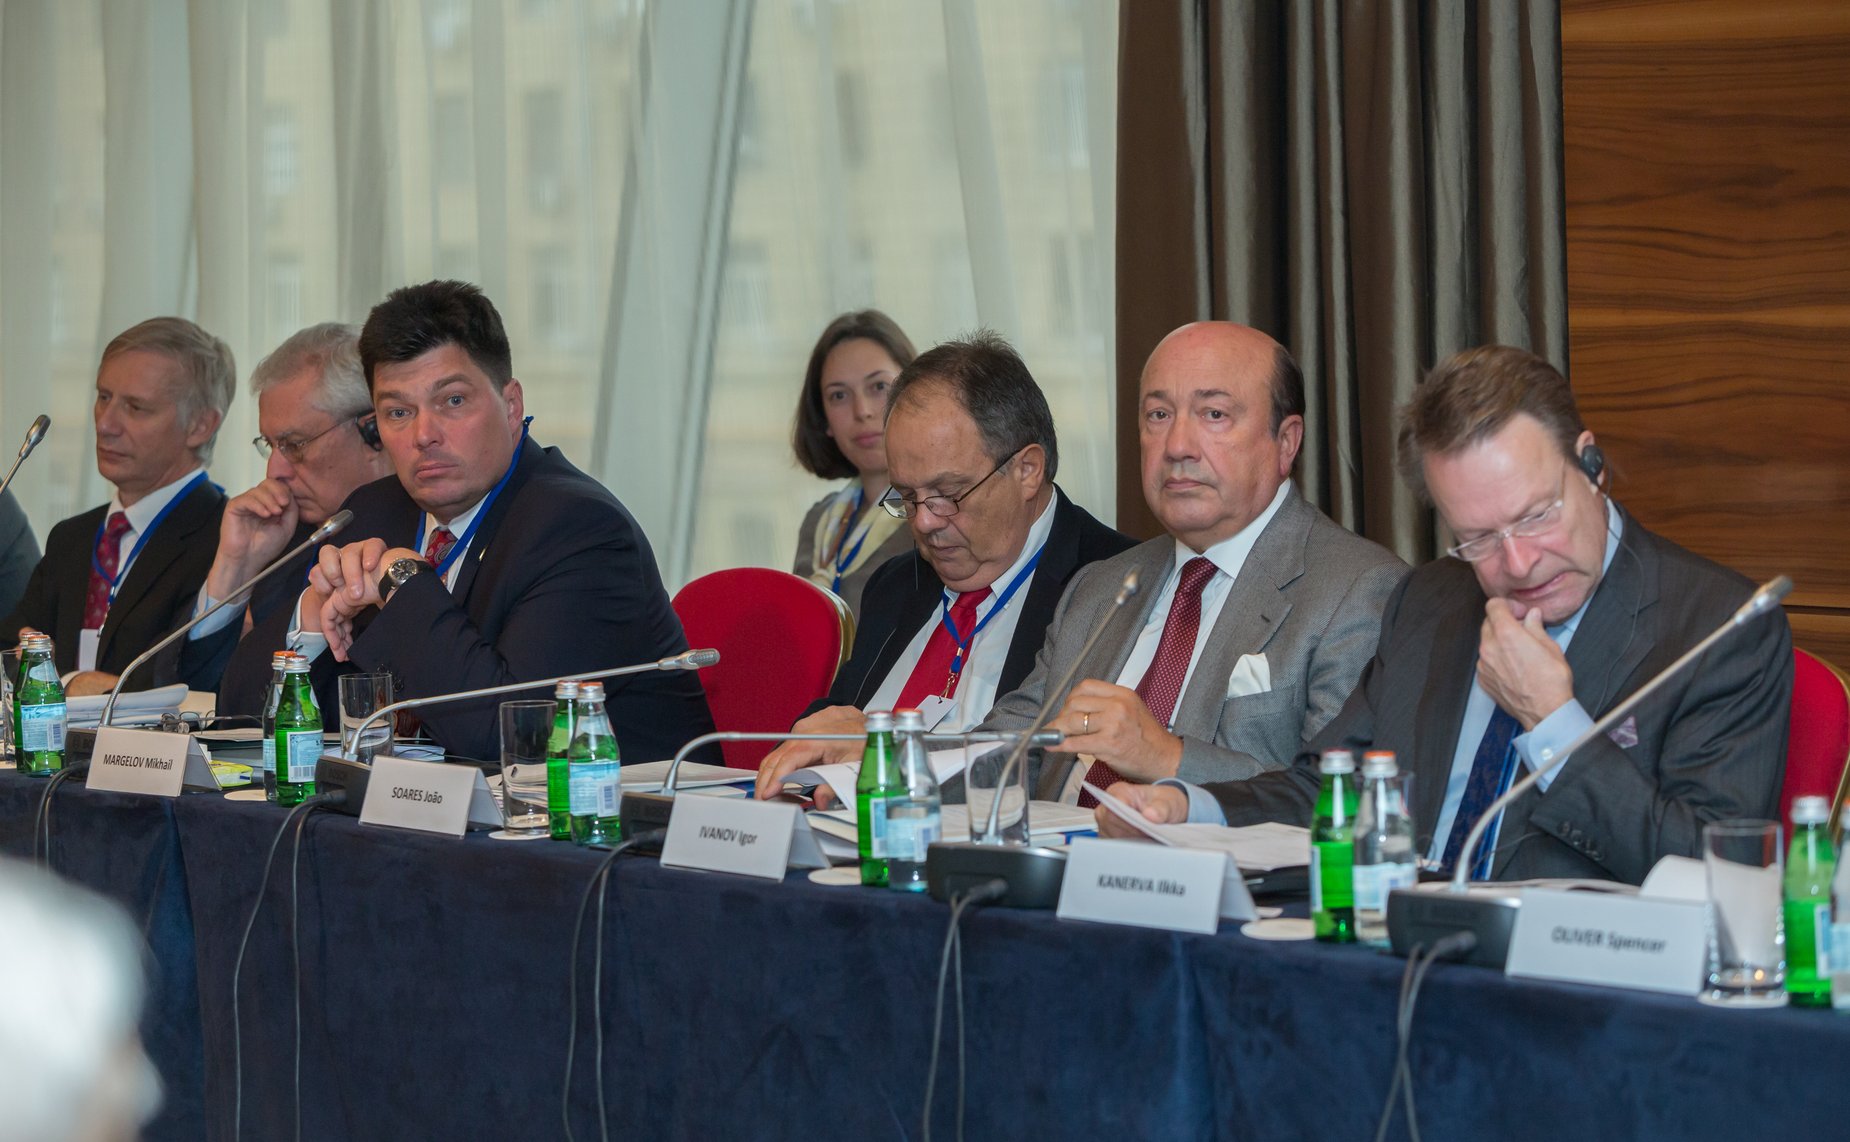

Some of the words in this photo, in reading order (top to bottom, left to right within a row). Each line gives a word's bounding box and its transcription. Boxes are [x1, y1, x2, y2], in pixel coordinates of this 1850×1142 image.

[103, 754, 144, 768] MARGELOV
[144, 758, 173, 770] Mikhail
[392, 787, 422, 801] SOARES
[423, 791, 443, 803] João
[699, 826, 737, 841] IVANOV
[738, 830, 758, 846] Igor
[1097, 873, 1154, 892] KANERVA
